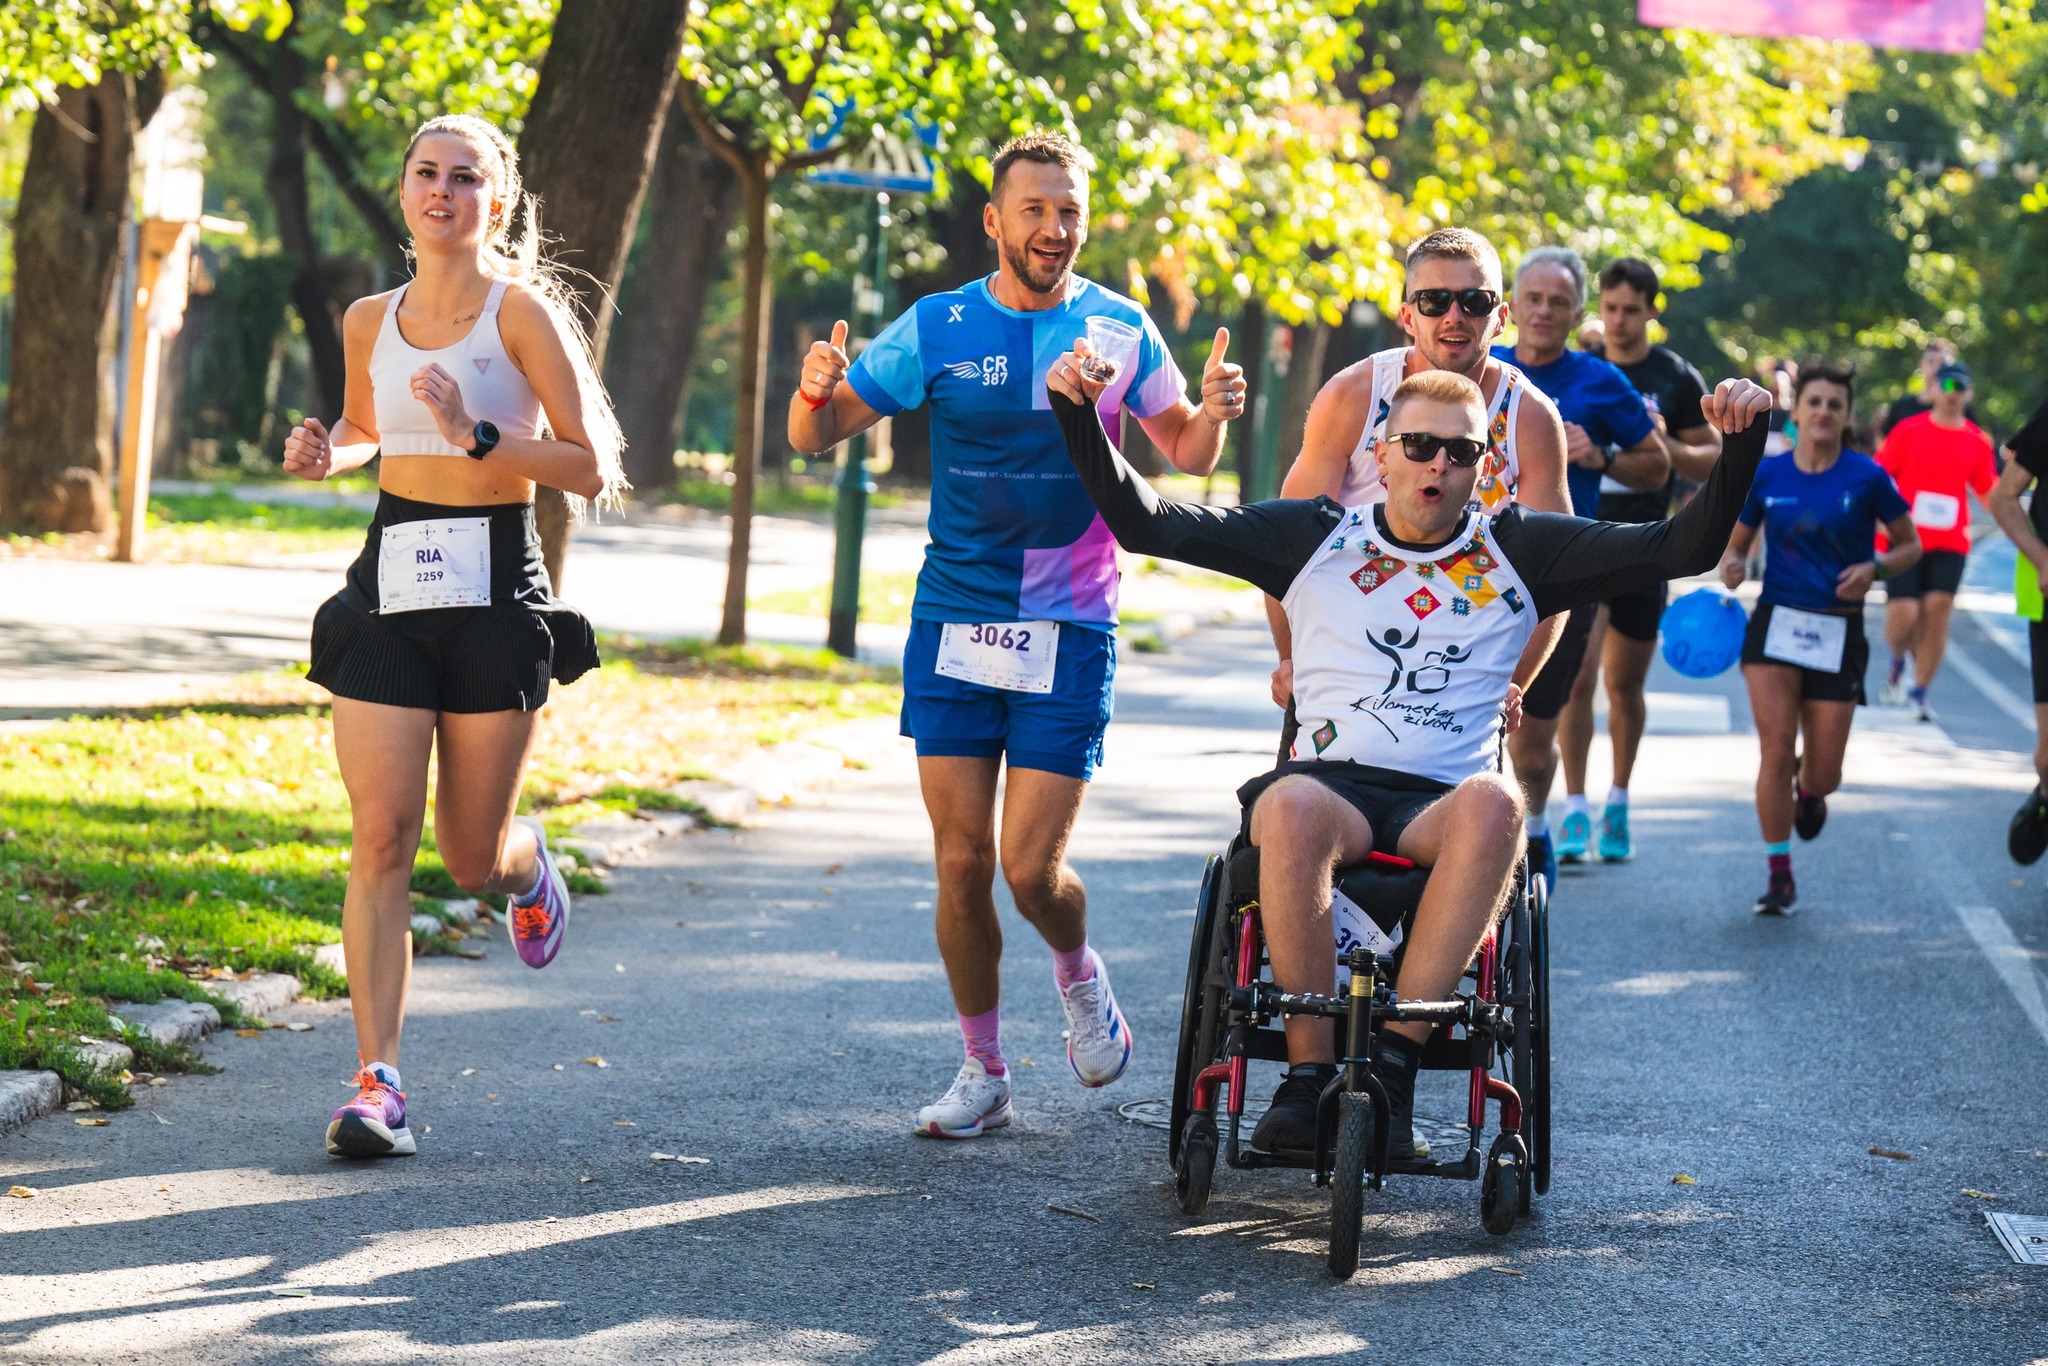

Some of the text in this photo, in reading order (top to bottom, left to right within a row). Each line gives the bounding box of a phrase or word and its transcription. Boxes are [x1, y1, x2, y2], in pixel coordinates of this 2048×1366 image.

[982, 355, 1008, 373] CR
[982, 372, 1008, 386] 387
[416, 548, 443, 564] RIA
[416, 571, 444, 582] 2259
[970, 624, 1031, 651] 3062
